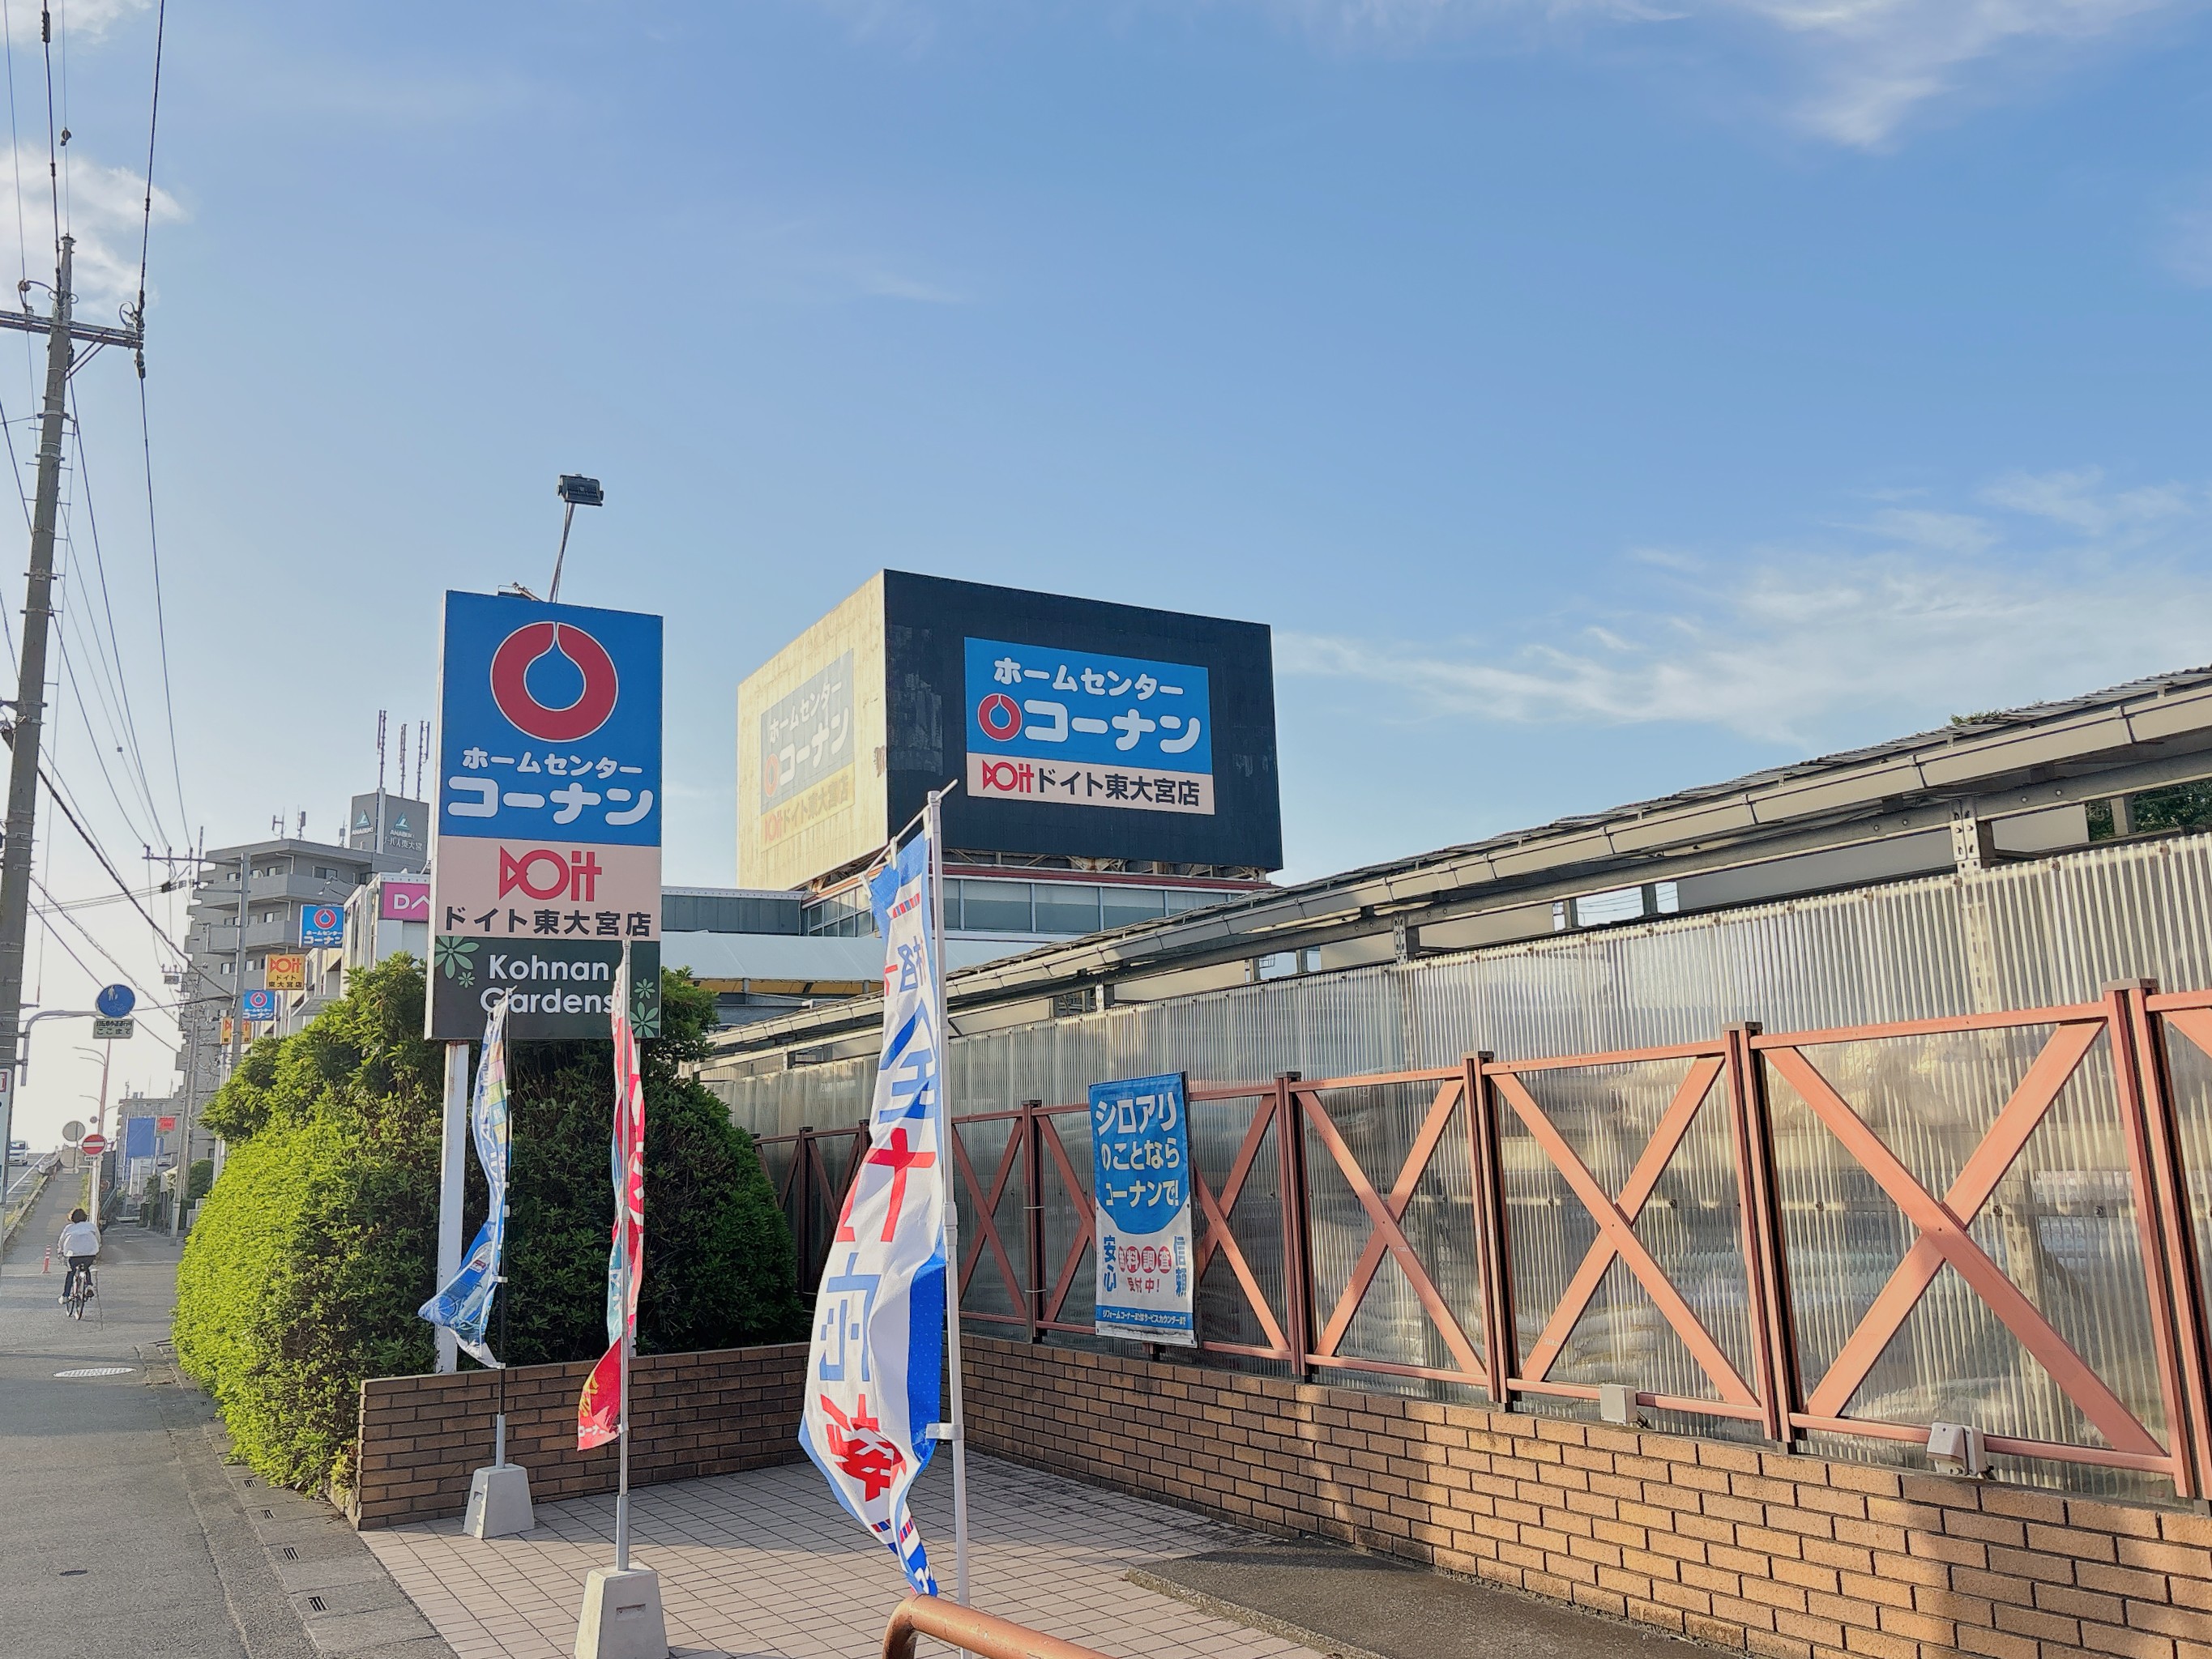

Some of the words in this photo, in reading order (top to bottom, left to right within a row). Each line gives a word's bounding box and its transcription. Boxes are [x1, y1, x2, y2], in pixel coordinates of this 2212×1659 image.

[994, 657, 1184, 701] ホームセンター
[770, 681, 842, 744] ホームセンター
[1024, 699, 1200, 753] コーナン
[463, 747, 643, 778] ホームセンター
[779, 706, 849, 786] コーナン
[448, 776, 653, 825] コーナン
[1039, 768, 1200, 807] ドイト東大宮店
[304, 936, 343, 945] コーナン
[446, 906, 651, 937] ドイト東大宮店
[489, 954, 609, 981] Kohnan
[480, 987, 613, 1015] Gardens
[1095, 1091, 1177, 1137] シロアリ
[1100, 1137, 1180, 1171] のことなら
[1104, 1235, 1117, 1292] 安心
[1173, 1236, 1187, 1297] 信頼
